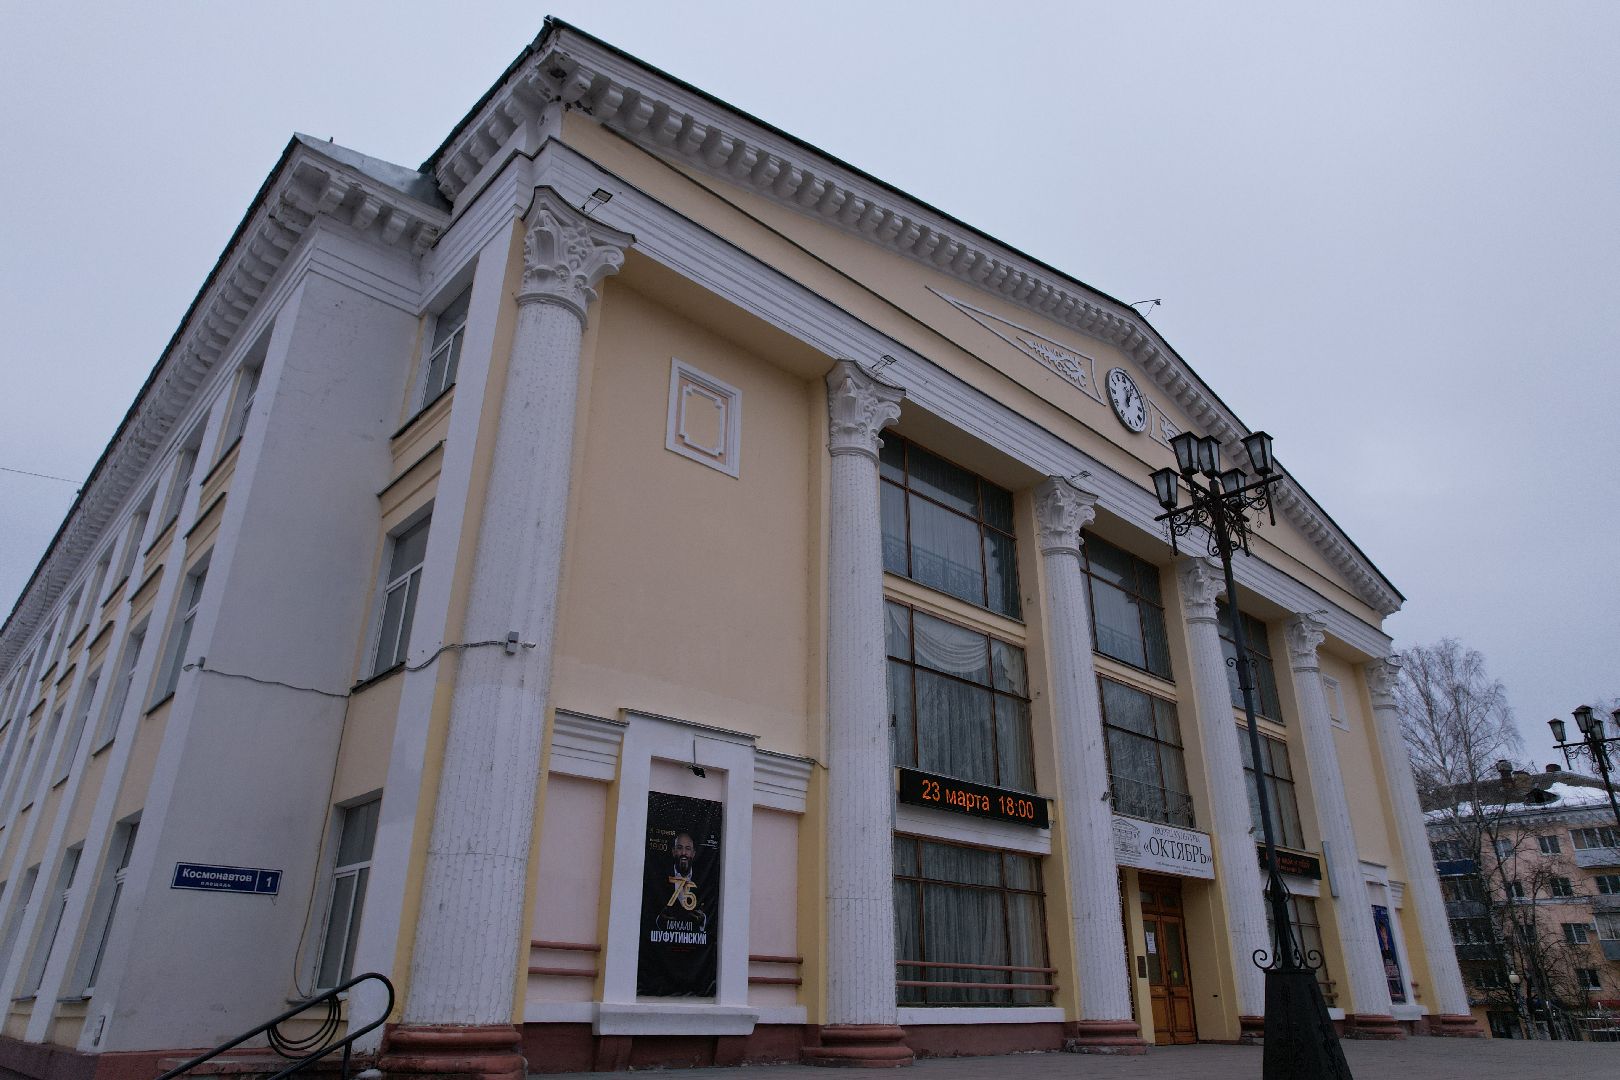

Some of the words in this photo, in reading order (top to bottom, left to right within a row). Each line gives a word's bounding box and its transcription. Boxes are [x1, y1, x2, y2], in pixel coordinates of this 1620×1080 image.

[922, 779, 941, 802] 23
[945, 788, 990, 812] марта
[998, 795, 1034, 820] 18:00
[1143, 836, 1212, 864] «ОКТЯБРЬ»
[182, 868, 253, 882] Космонавтов
[266, 876, 272, 887] 1
[666, 876, 698, 911] 75
[666, 920, 693, 931] МИХАИЛ
[650, 930, 707, 945] ШУФУТИНСКИЙ
